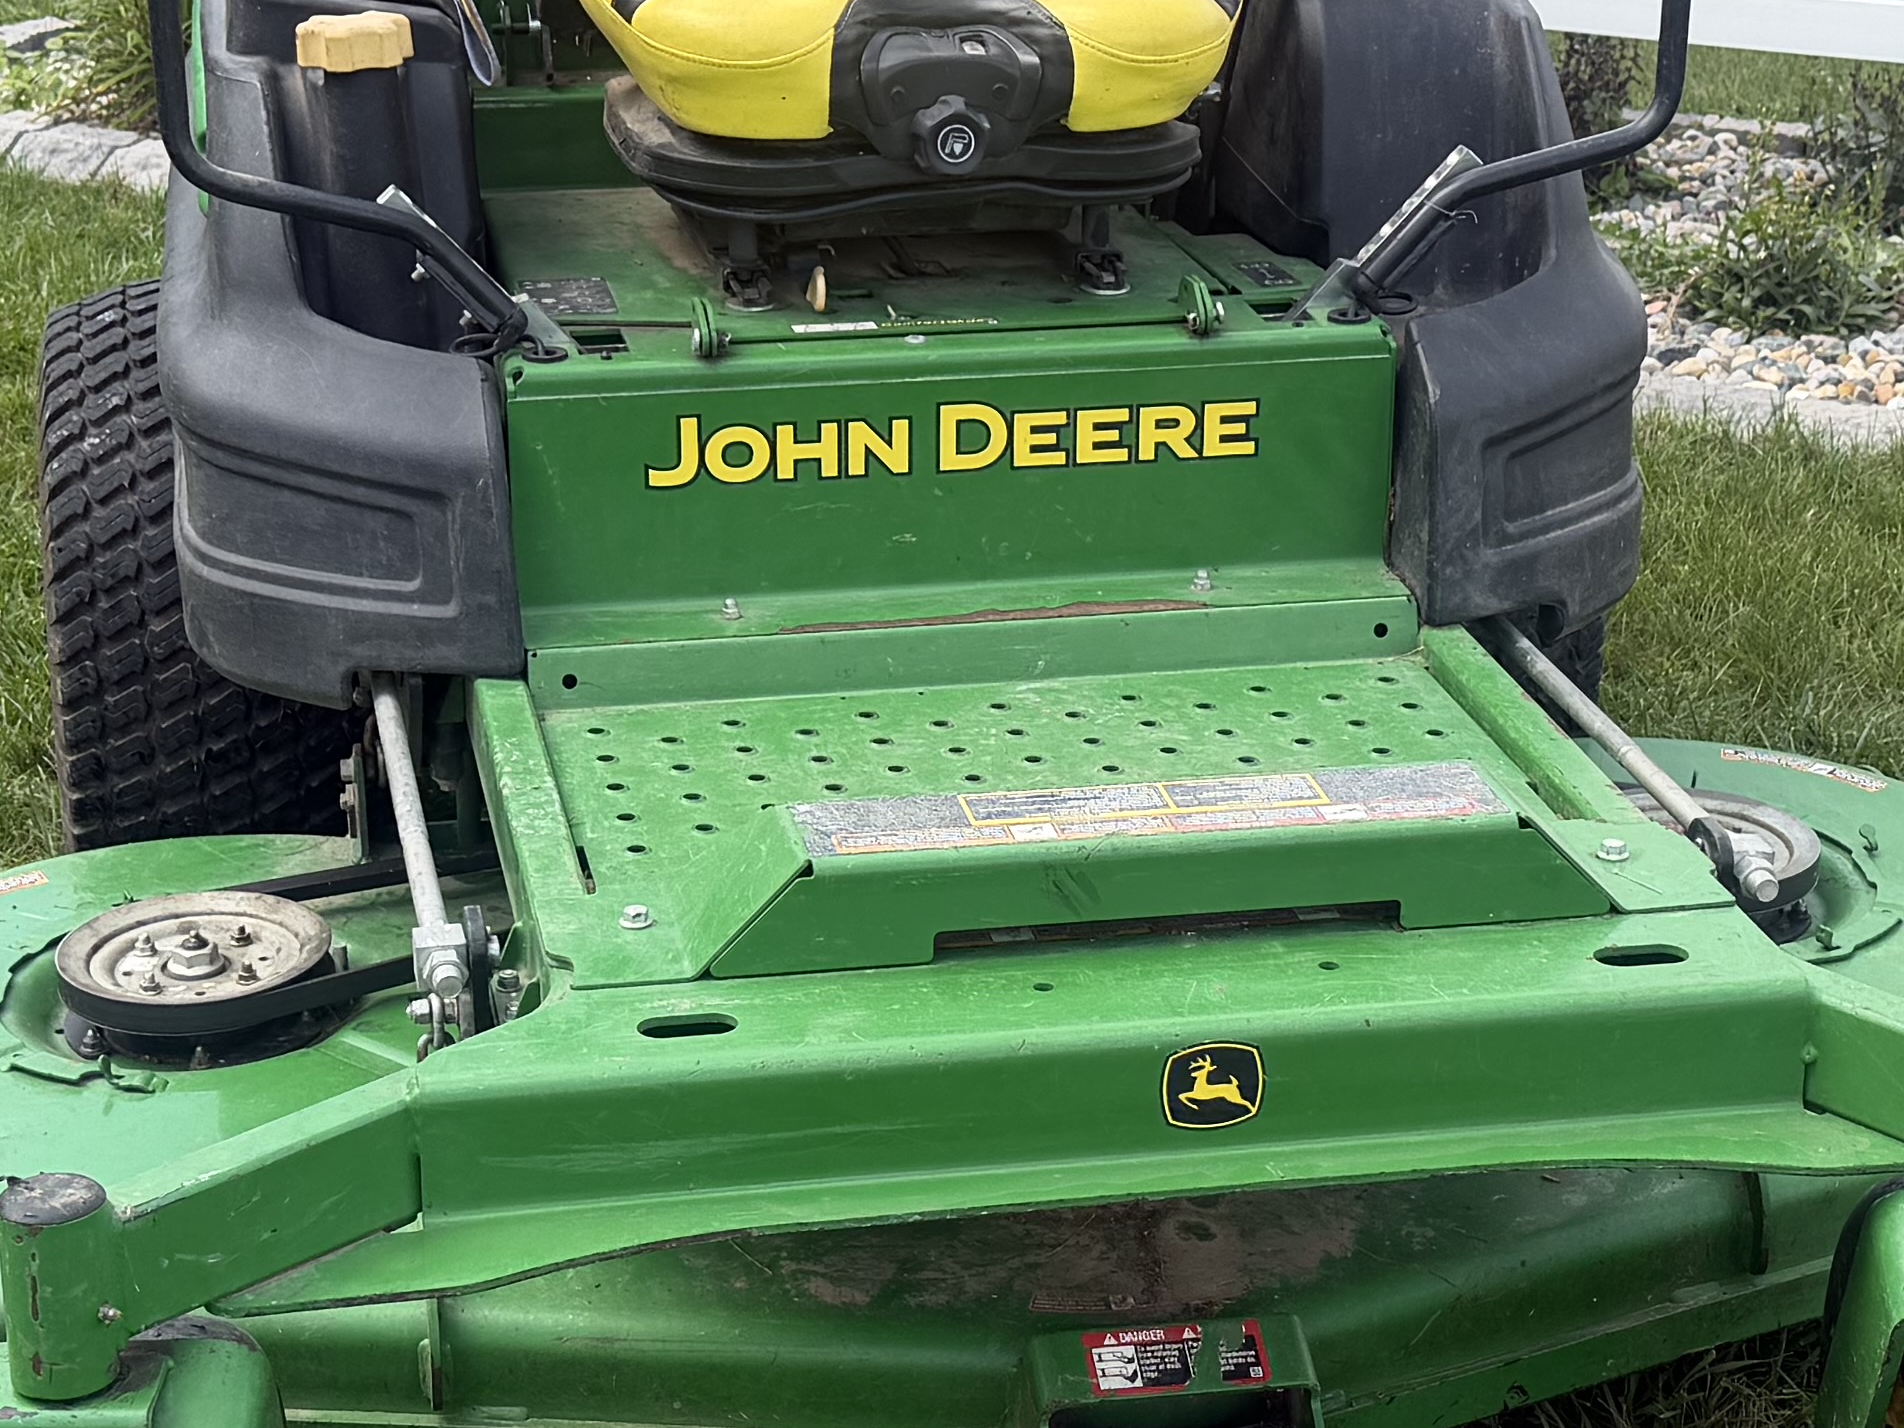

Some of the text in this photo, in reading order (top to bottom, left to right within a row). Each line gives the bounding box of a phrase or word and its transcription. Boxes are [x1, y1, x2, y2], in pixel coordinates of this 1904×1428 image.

[645, 398, 1261, 489] JOHN DEERE
[1119, 1329, 1166, 1344] DANGER
